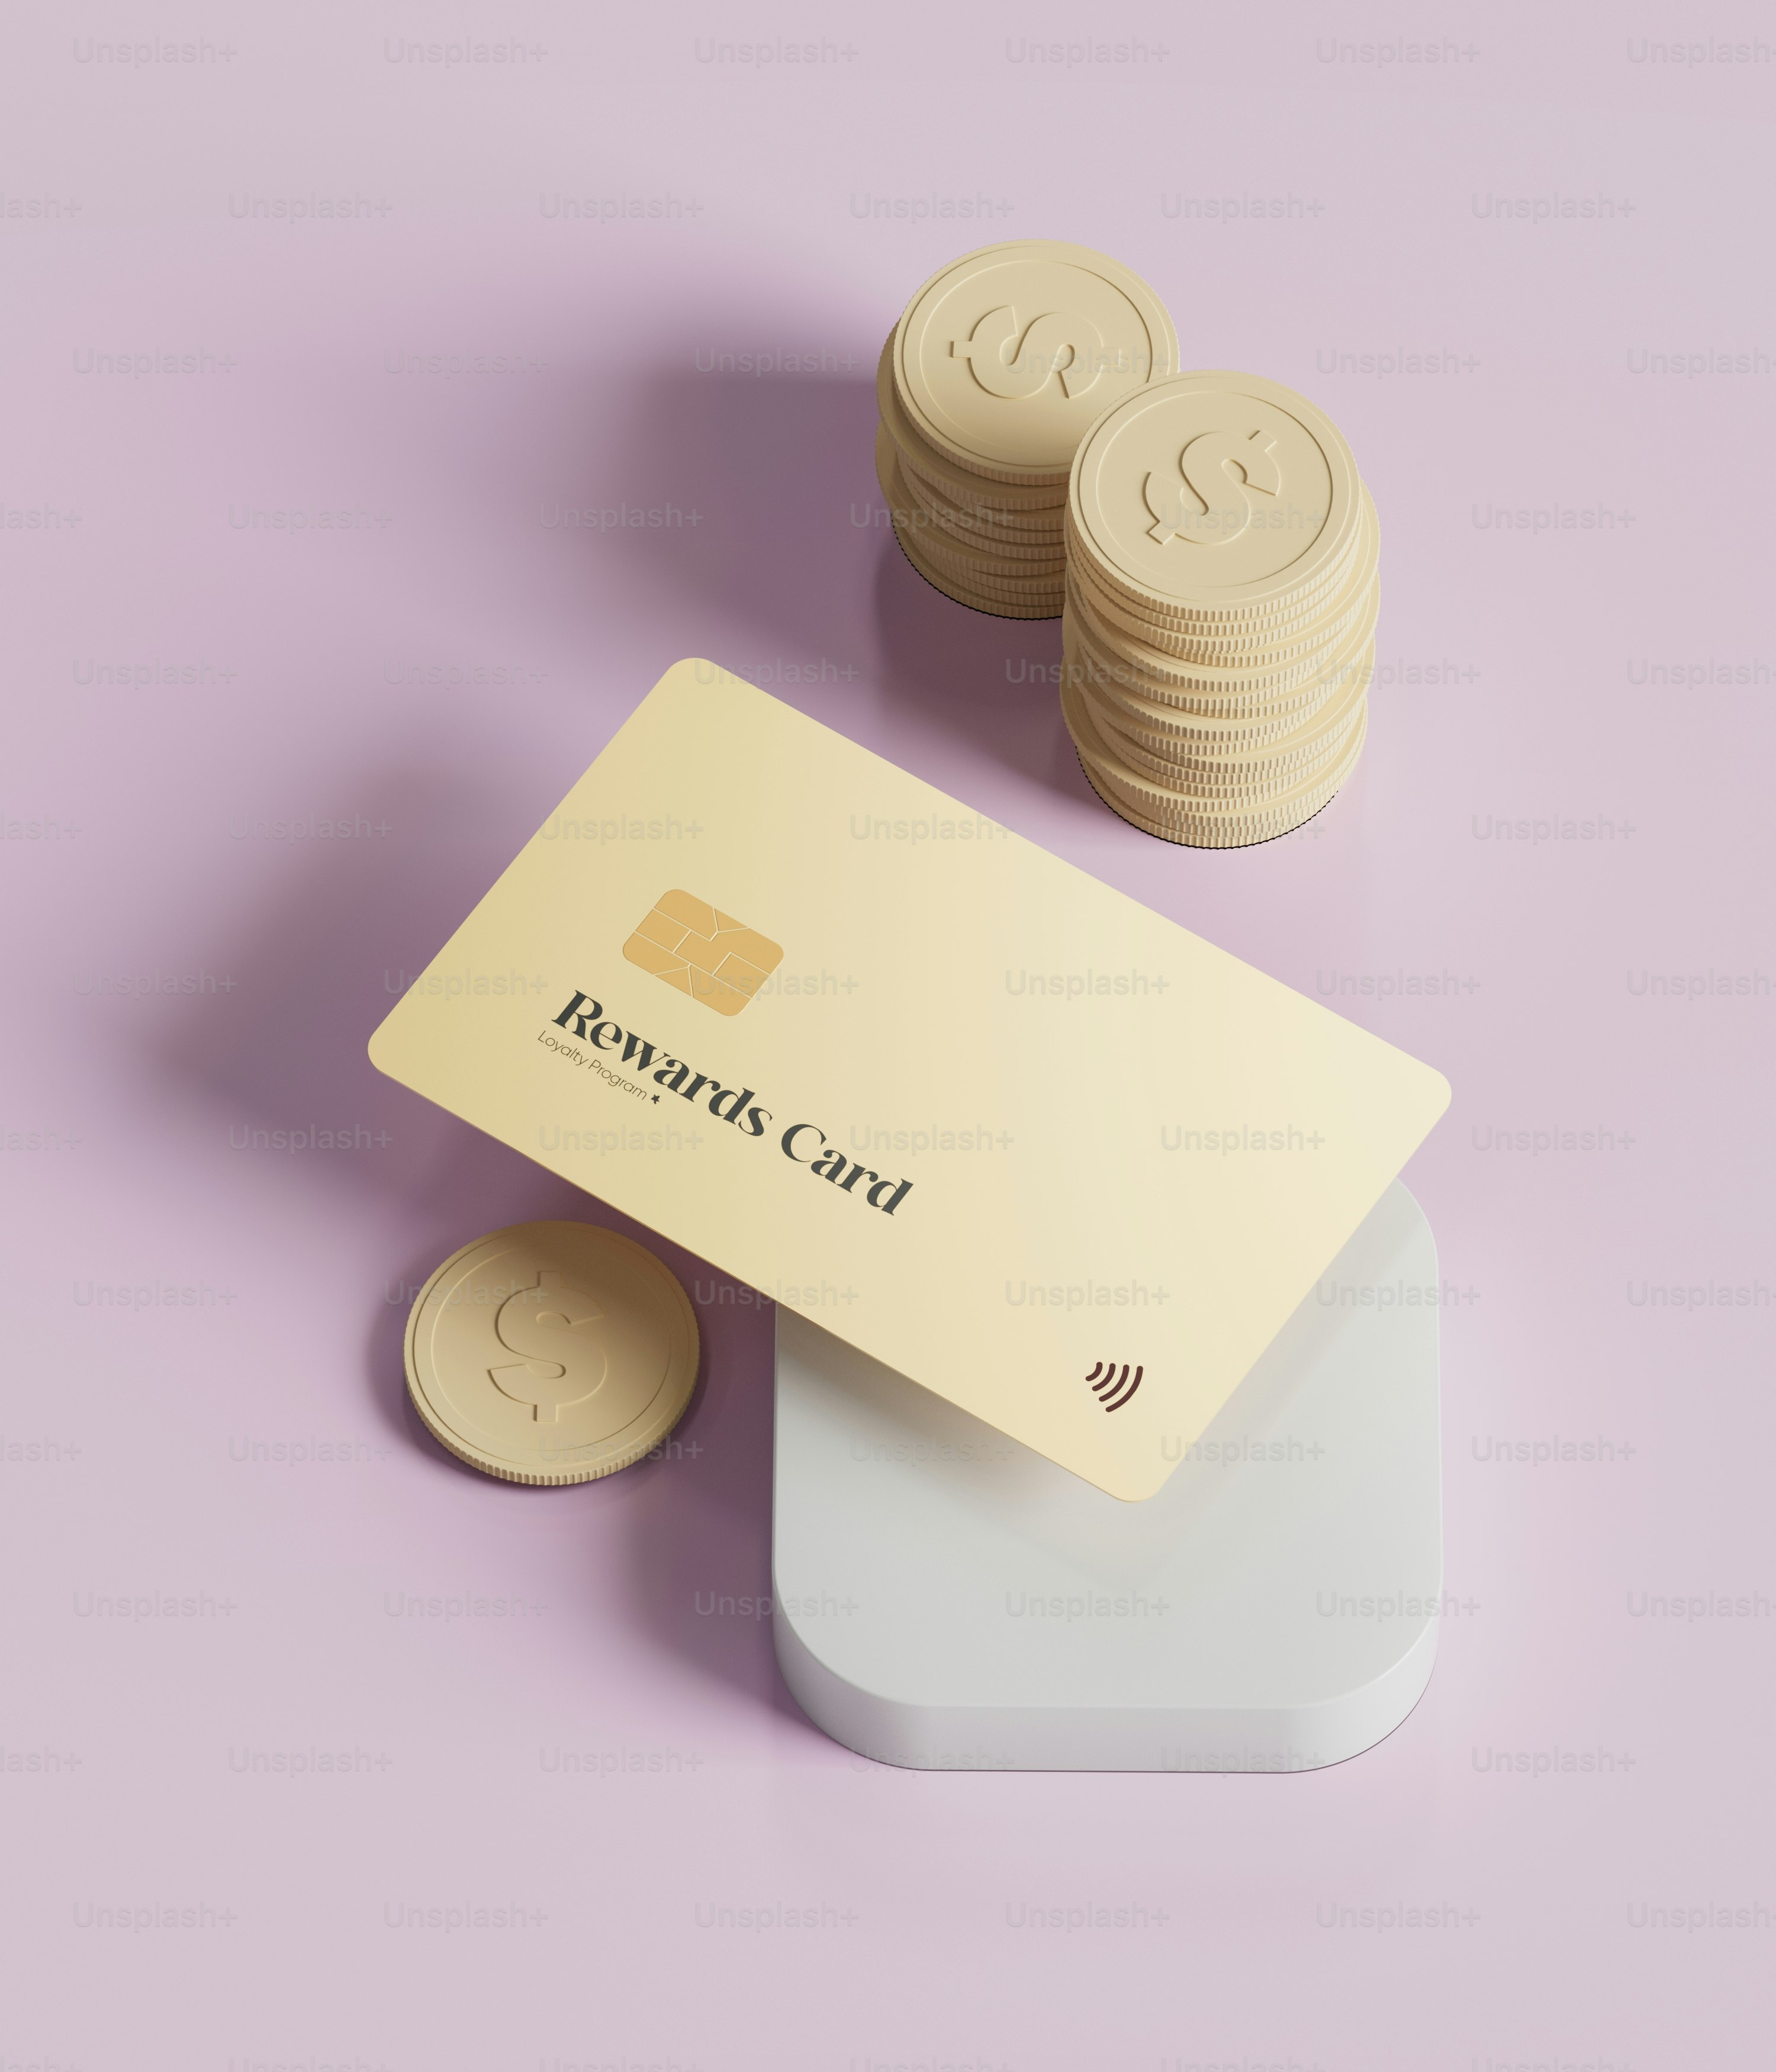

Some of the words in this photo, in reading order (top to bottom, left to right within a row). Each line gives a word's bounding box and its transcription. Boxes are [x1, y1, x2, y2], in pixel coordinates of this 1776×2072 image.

[537, 1030, 589, 1066] Loyalty
[588, 1059, 647, 1100] Program
[551, 989, 773, 1137] Rewards
[781, 1124, 914, 1216] Card
